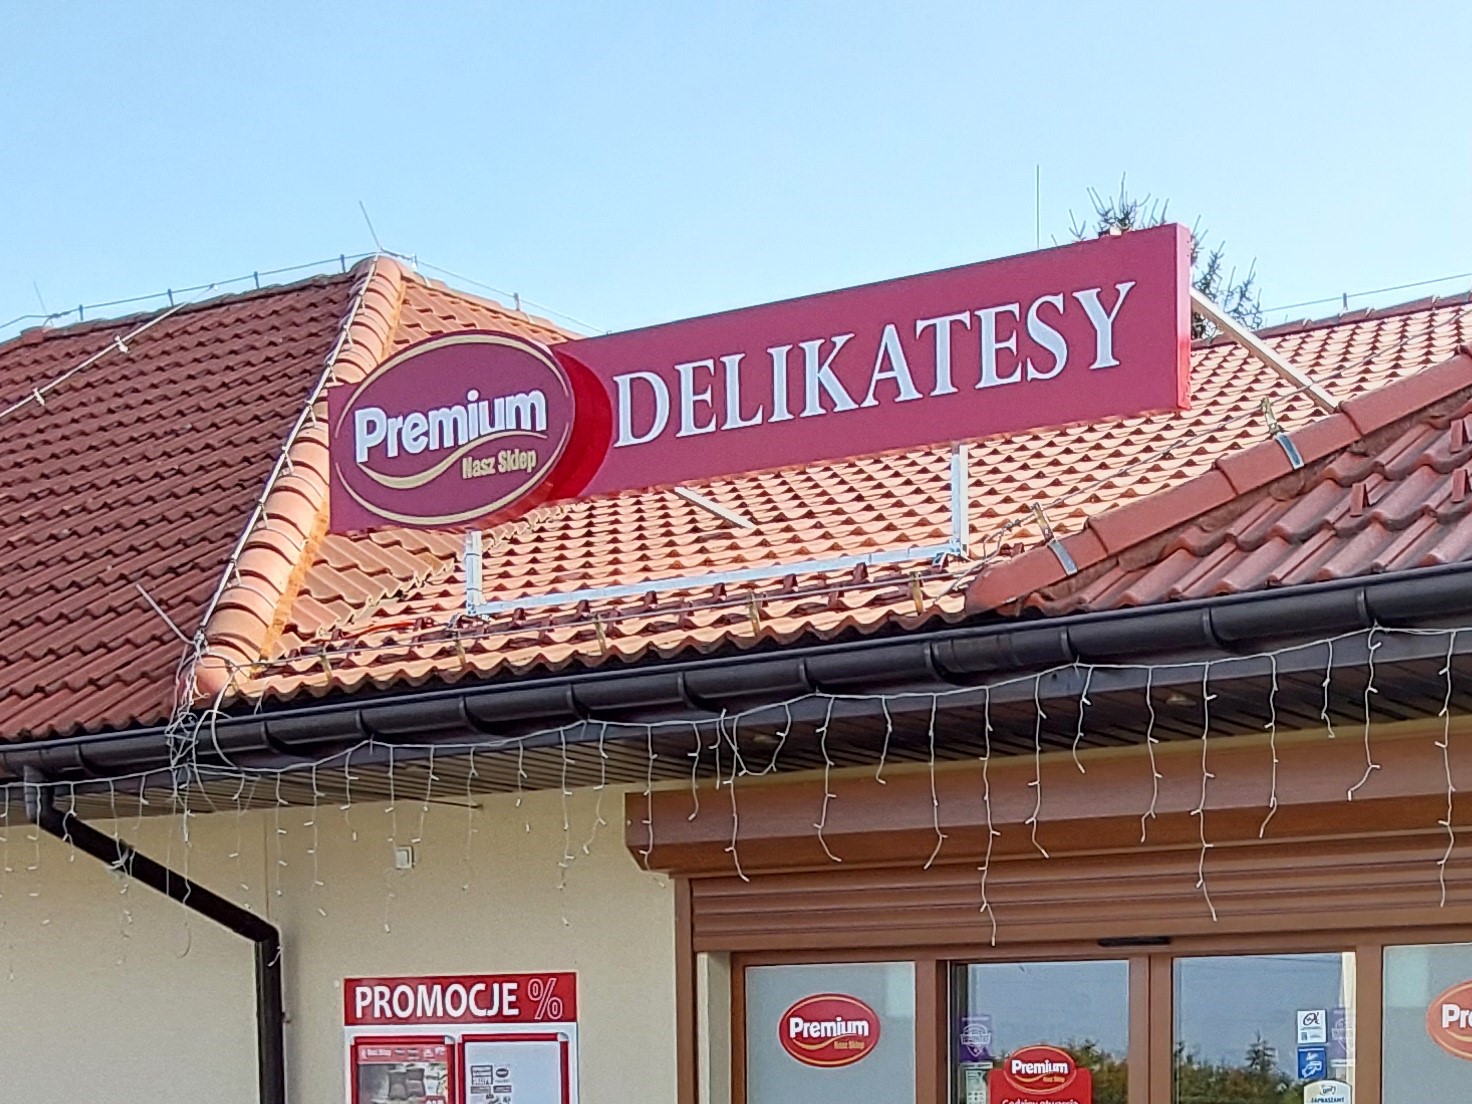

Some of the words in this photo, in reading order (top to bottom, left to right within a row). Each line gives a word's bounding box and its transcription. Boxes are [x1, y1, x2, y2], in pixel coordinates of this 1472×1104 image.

[612, 280, 1136, 449] DELIKATESY
[355, 389, 546, 463] Premium
[462, 456, 496, 479] Nasz
[498, 449, 537, 473] Sklep
[355, 982, 519, 1018] PROMOCJE
[528, 978, 563, 1020] %
[789, 1016, 869, 1038] Premium
[1012, 1059, 1068, 1074] Premium
